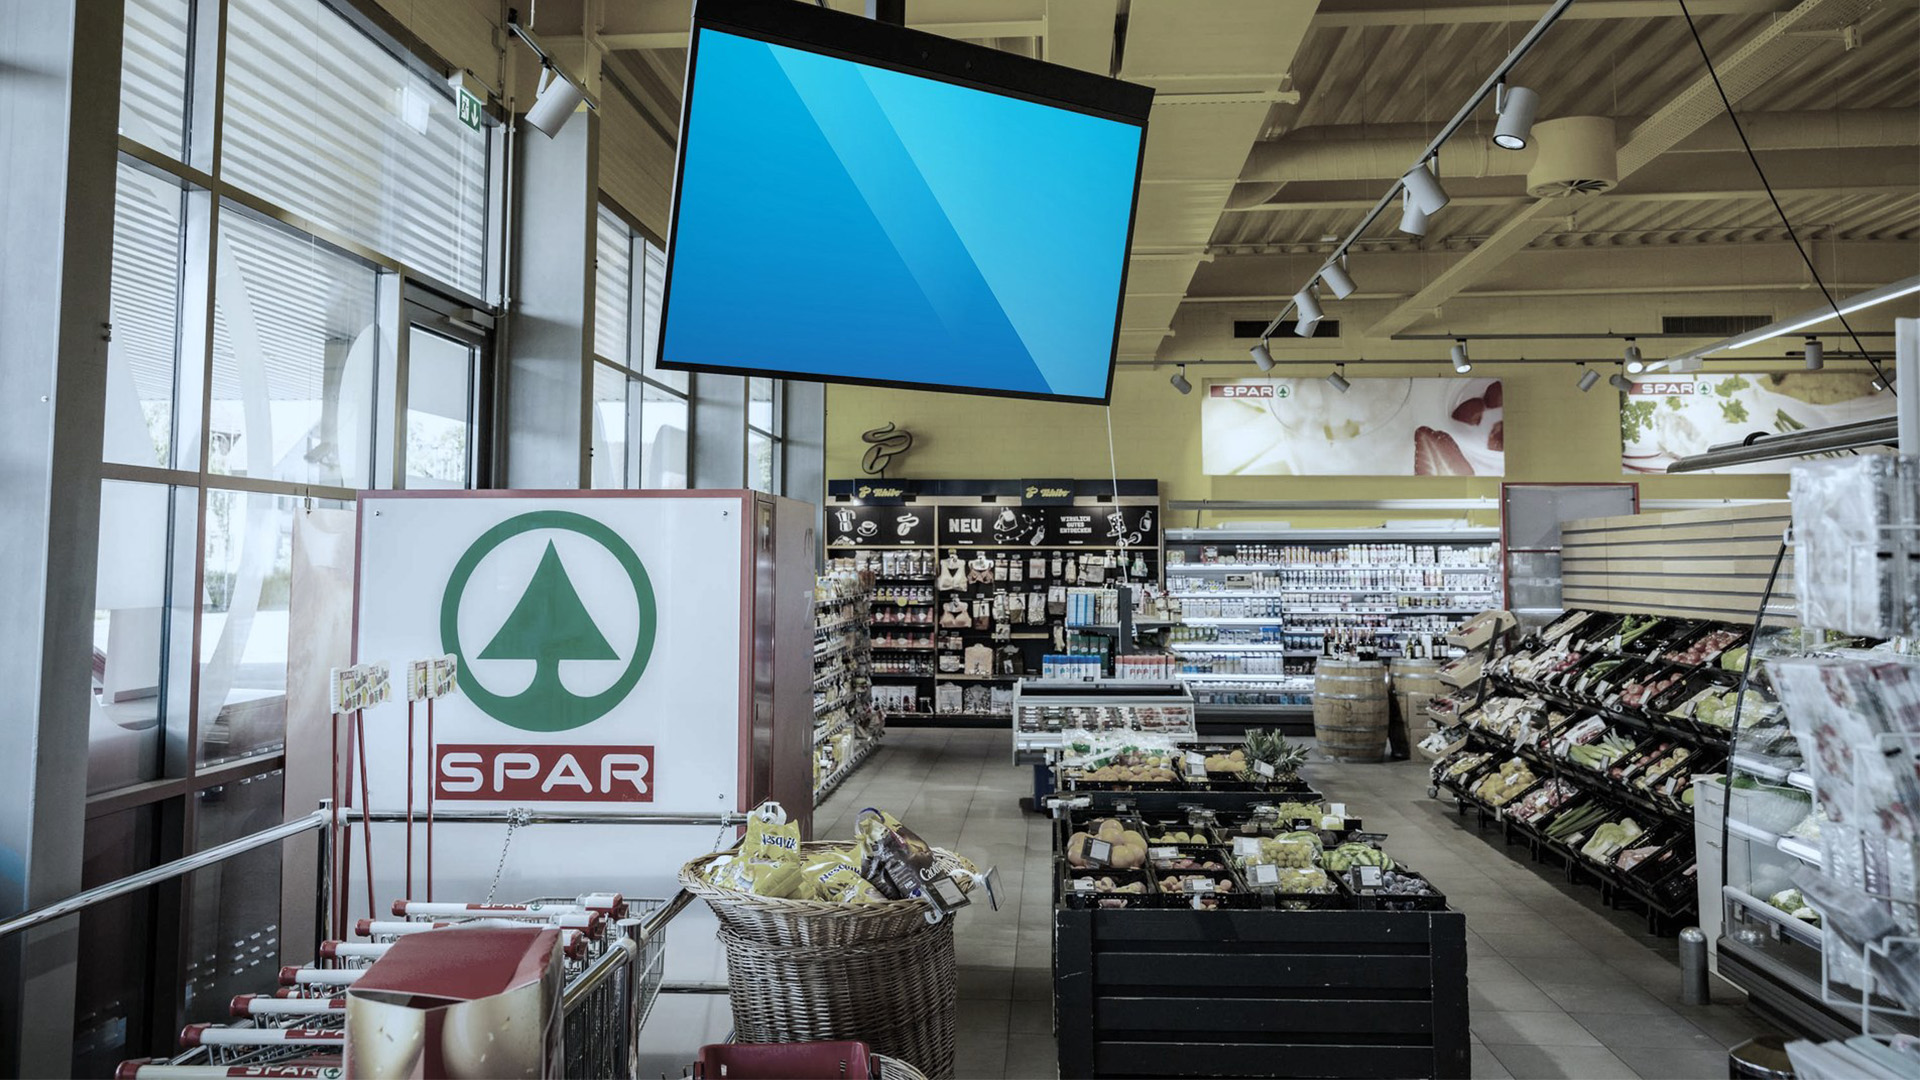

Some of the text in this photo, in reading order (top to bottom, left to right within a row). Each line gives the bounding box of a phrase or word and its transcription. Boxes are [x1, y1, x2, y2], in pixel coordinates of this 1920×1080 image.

[1223, 386, 1273, 397] SPAR
[1642, 383, 1693, 394] SPAR
[949, 518, 983, 533] NEU
[440, 752, 650, 794] SPAR
[245, 1066, 319, 1075] SPAR
